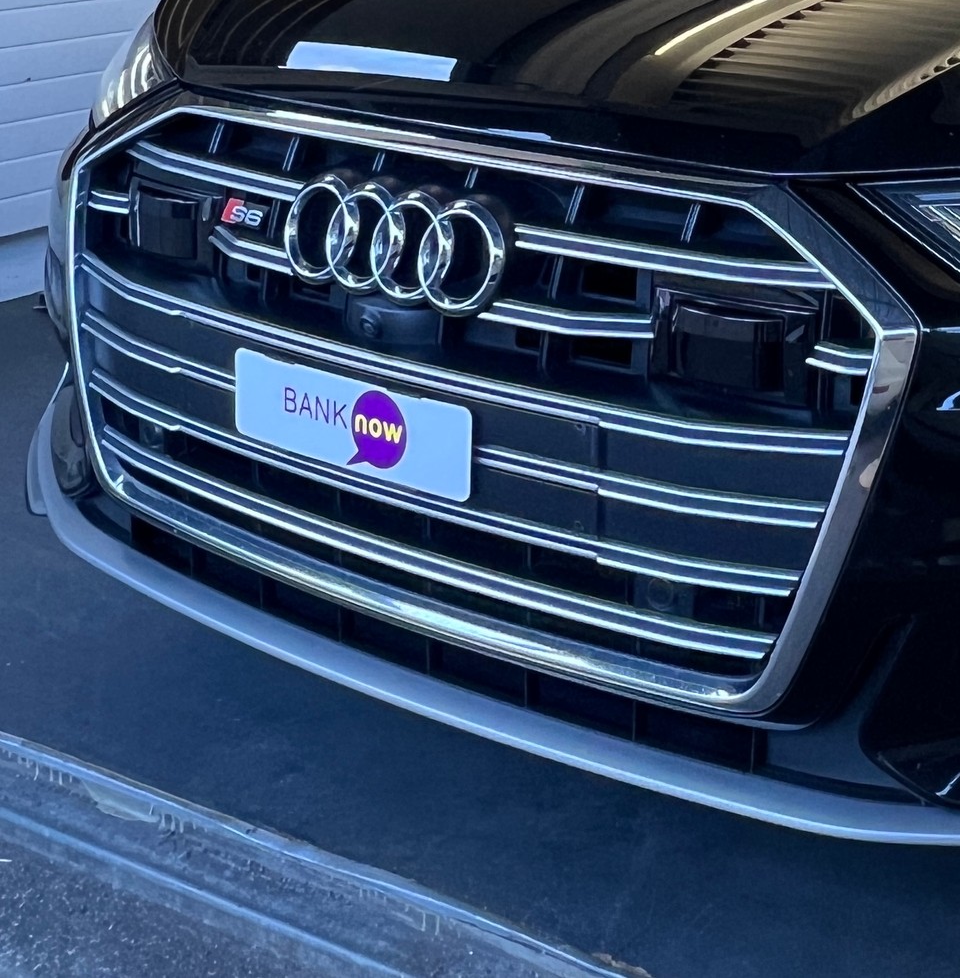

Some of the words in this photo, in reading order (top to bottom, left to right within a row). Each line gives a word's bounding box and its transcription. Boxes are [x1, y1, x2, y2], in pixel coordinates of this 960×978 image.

[228, 203, 264, 226] S6
[284, 387, 348, 429] BANK
[354, 413, 403, 444] now
